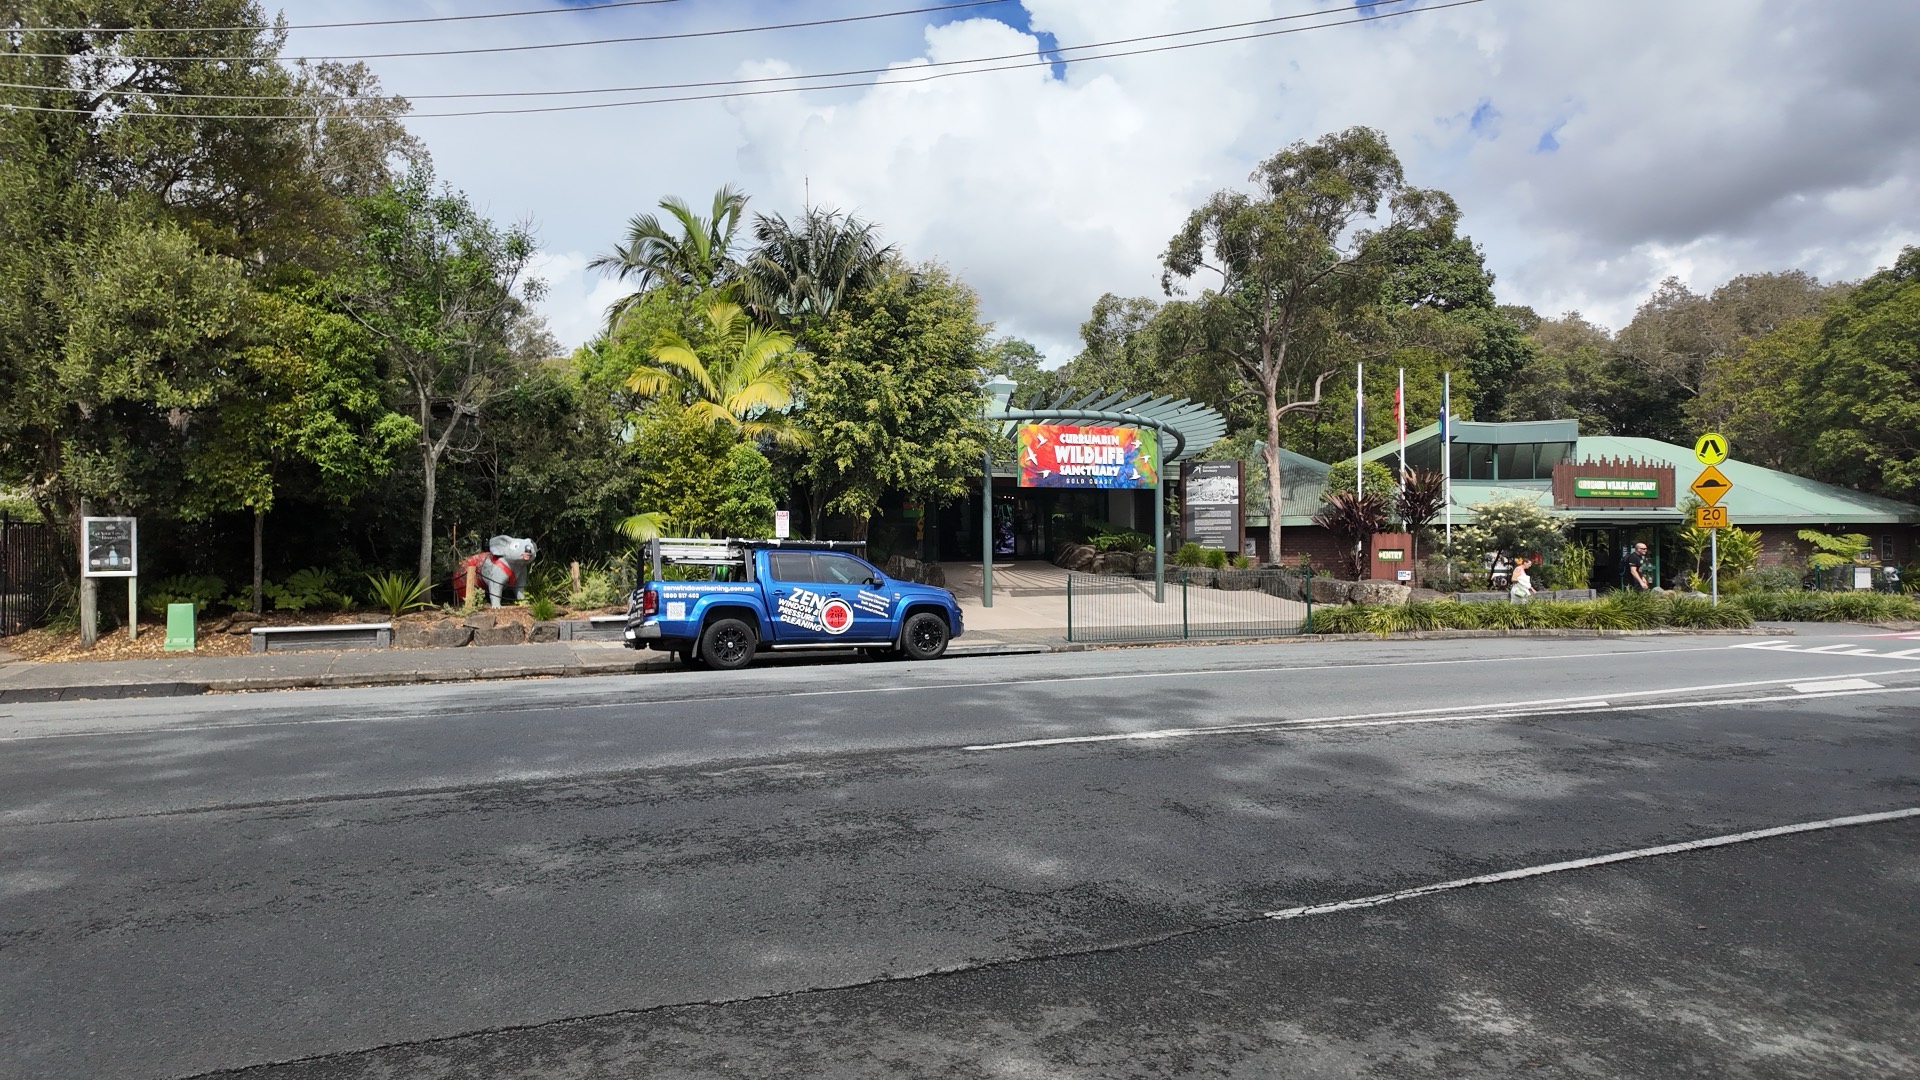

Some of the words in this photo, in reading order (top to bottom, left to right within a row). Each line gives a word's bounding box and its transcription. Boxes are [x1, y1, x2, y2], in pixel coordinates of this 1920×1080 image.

[1059, 433, 1119, 445] CURRUMBIN
[1054, 445, 1125, 464] WILDLIFE
[1059, 465, 1120, 476] SANCTUARY
[1607, 481, 1628, 490] WILDLIFE
[1628, 481, 1656, 490] SANCTUARY
[1702, 509, 1720, 521] 20
[1382, 551, 1403, 559] ENTRY
[788, 587, 826, 610] ZEN
[778, 598, 814, 613] WINDOW
[778, 605, 815, 622] PRESSURE
[780, 614, 822, 631] CLEANING
